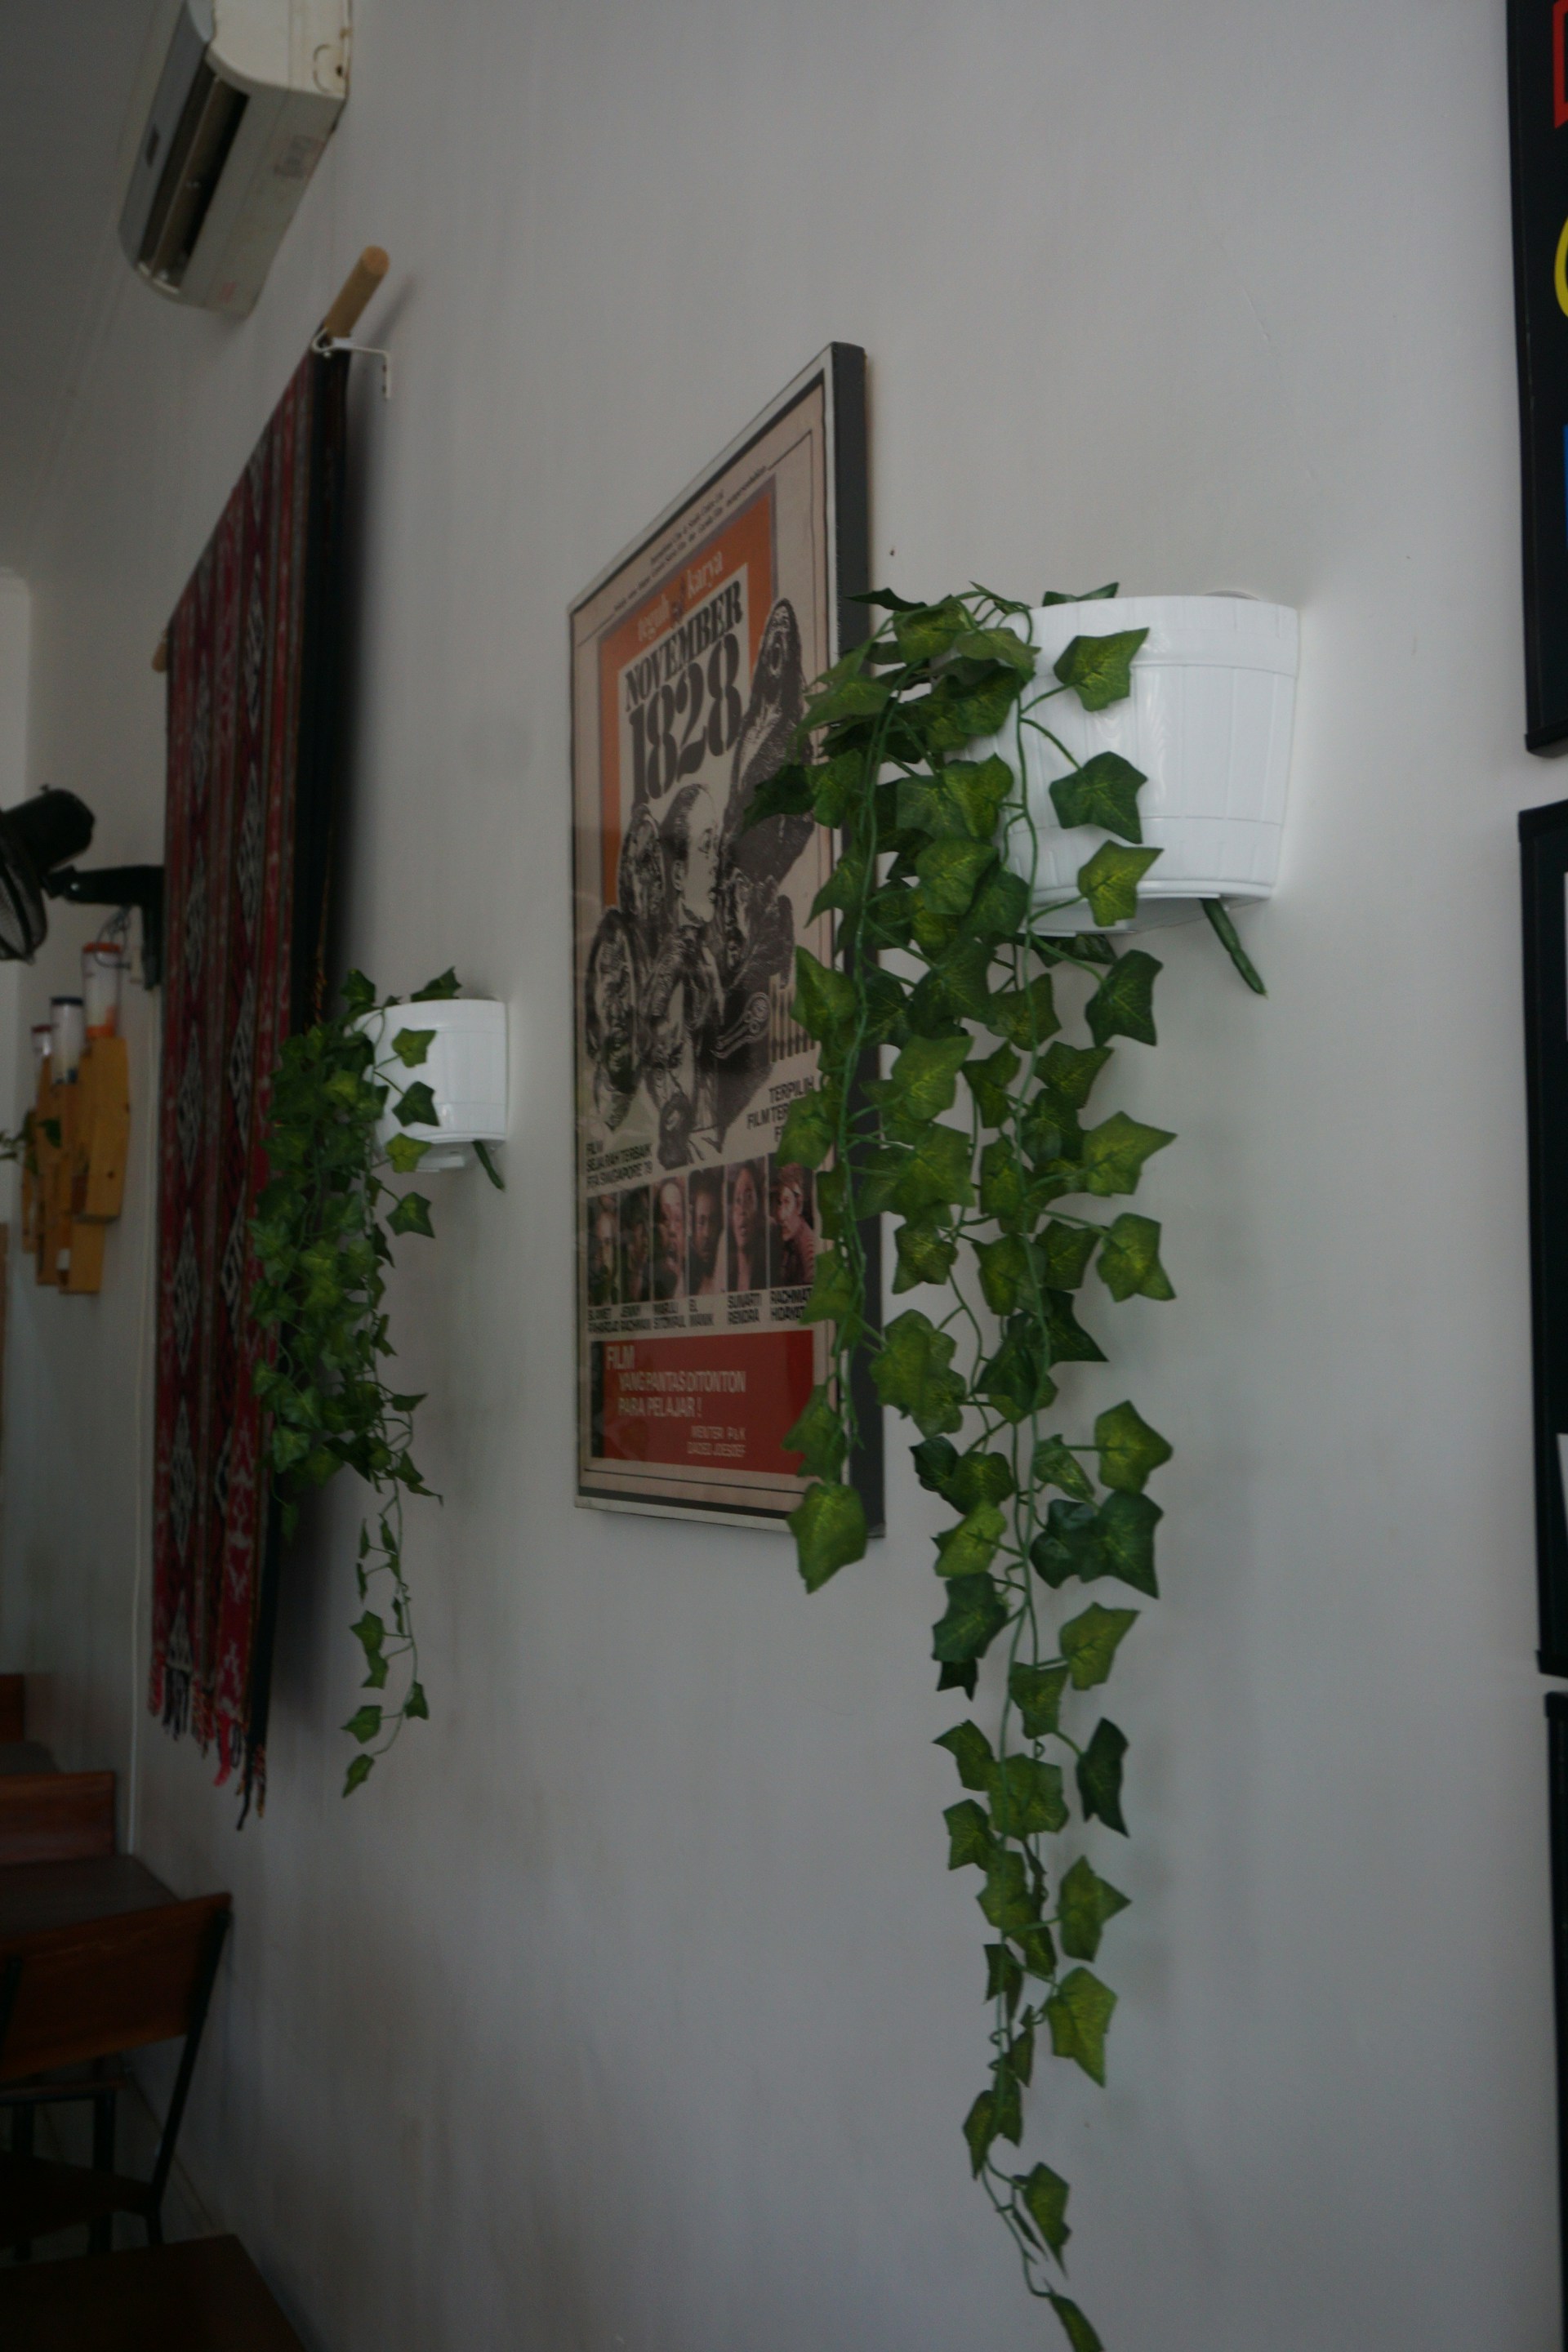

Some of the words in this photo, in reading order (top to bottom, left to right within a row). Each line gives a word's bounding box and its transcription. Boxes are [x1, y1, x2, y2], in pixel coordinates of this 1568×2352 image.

[687, 550, 724, 599] karya
[626, 580, 743, 712] NOVEMBER
[629, 633, 742, 804] 1828
[606, 1345, 634, 1370] FILM
[618, 1397, 644, 1416] PARA
[647, 1397, 694, 1418] PELAJAR
